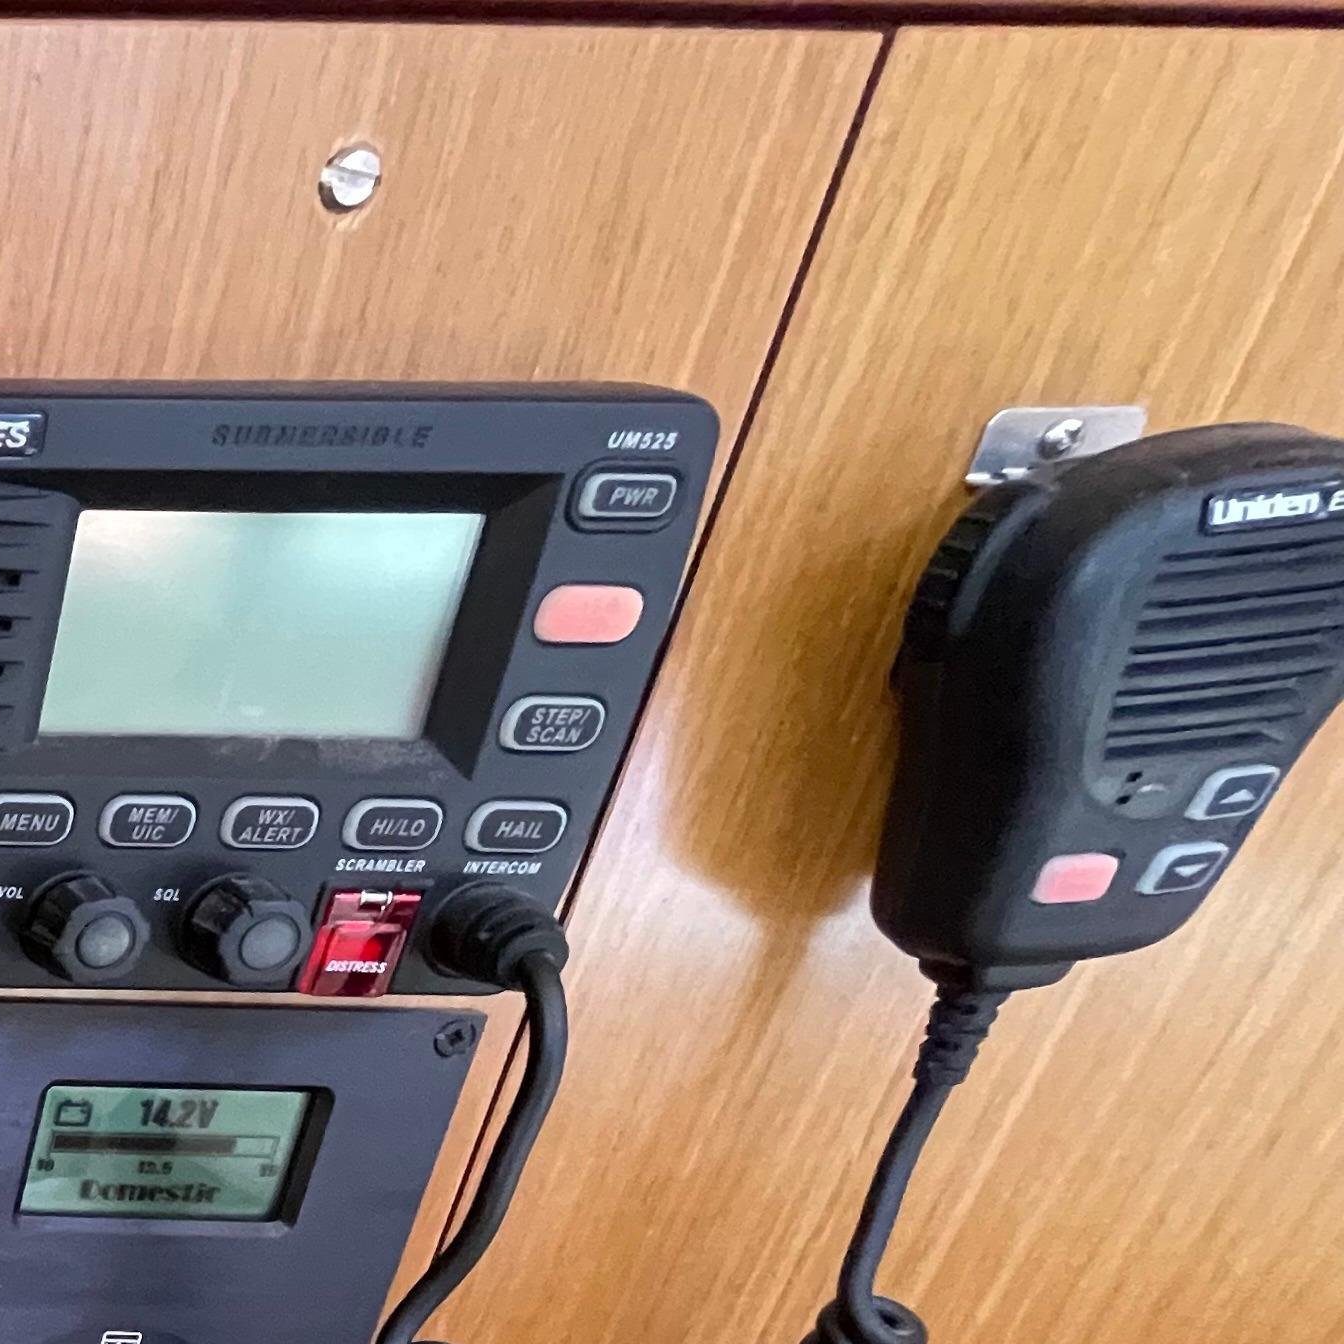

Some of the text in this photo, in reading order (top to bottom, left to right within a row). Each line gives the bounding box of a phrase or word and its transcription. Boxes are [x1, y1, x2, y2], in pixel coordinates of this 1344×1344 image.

[212, 424, 434, 448] SUBMERSIBLE
[607, 431, 677, 450] UM525
[609, 487, 658, 506] PWR
[1209, 493, 1320, 525] Uniden
[532, 708, 589, 725] STEP/
[526, 726, 583, 743] SCAN
[0, 814, 59, 832] MENU
[129, 808, 178, 824] MEM/
[259, 809, 293, 825] WX/
[131, 825, 166, 840] UIC
[239, 826, 302, 842] ALERT
[369, 819, 425, 837] HI/LO
[494, 821, 542, 840] HAIL
[335, 858, 426, 873] SCRAMBLER
[464, 860, 542, 874] INTERCOM
[153, 888, 180, 902] SQL
[324, 959, 387, 974] DISTRESS
[140, 1098, 219, 1128] 14.2V
[80, 1179, 221, 1201] Domestic
